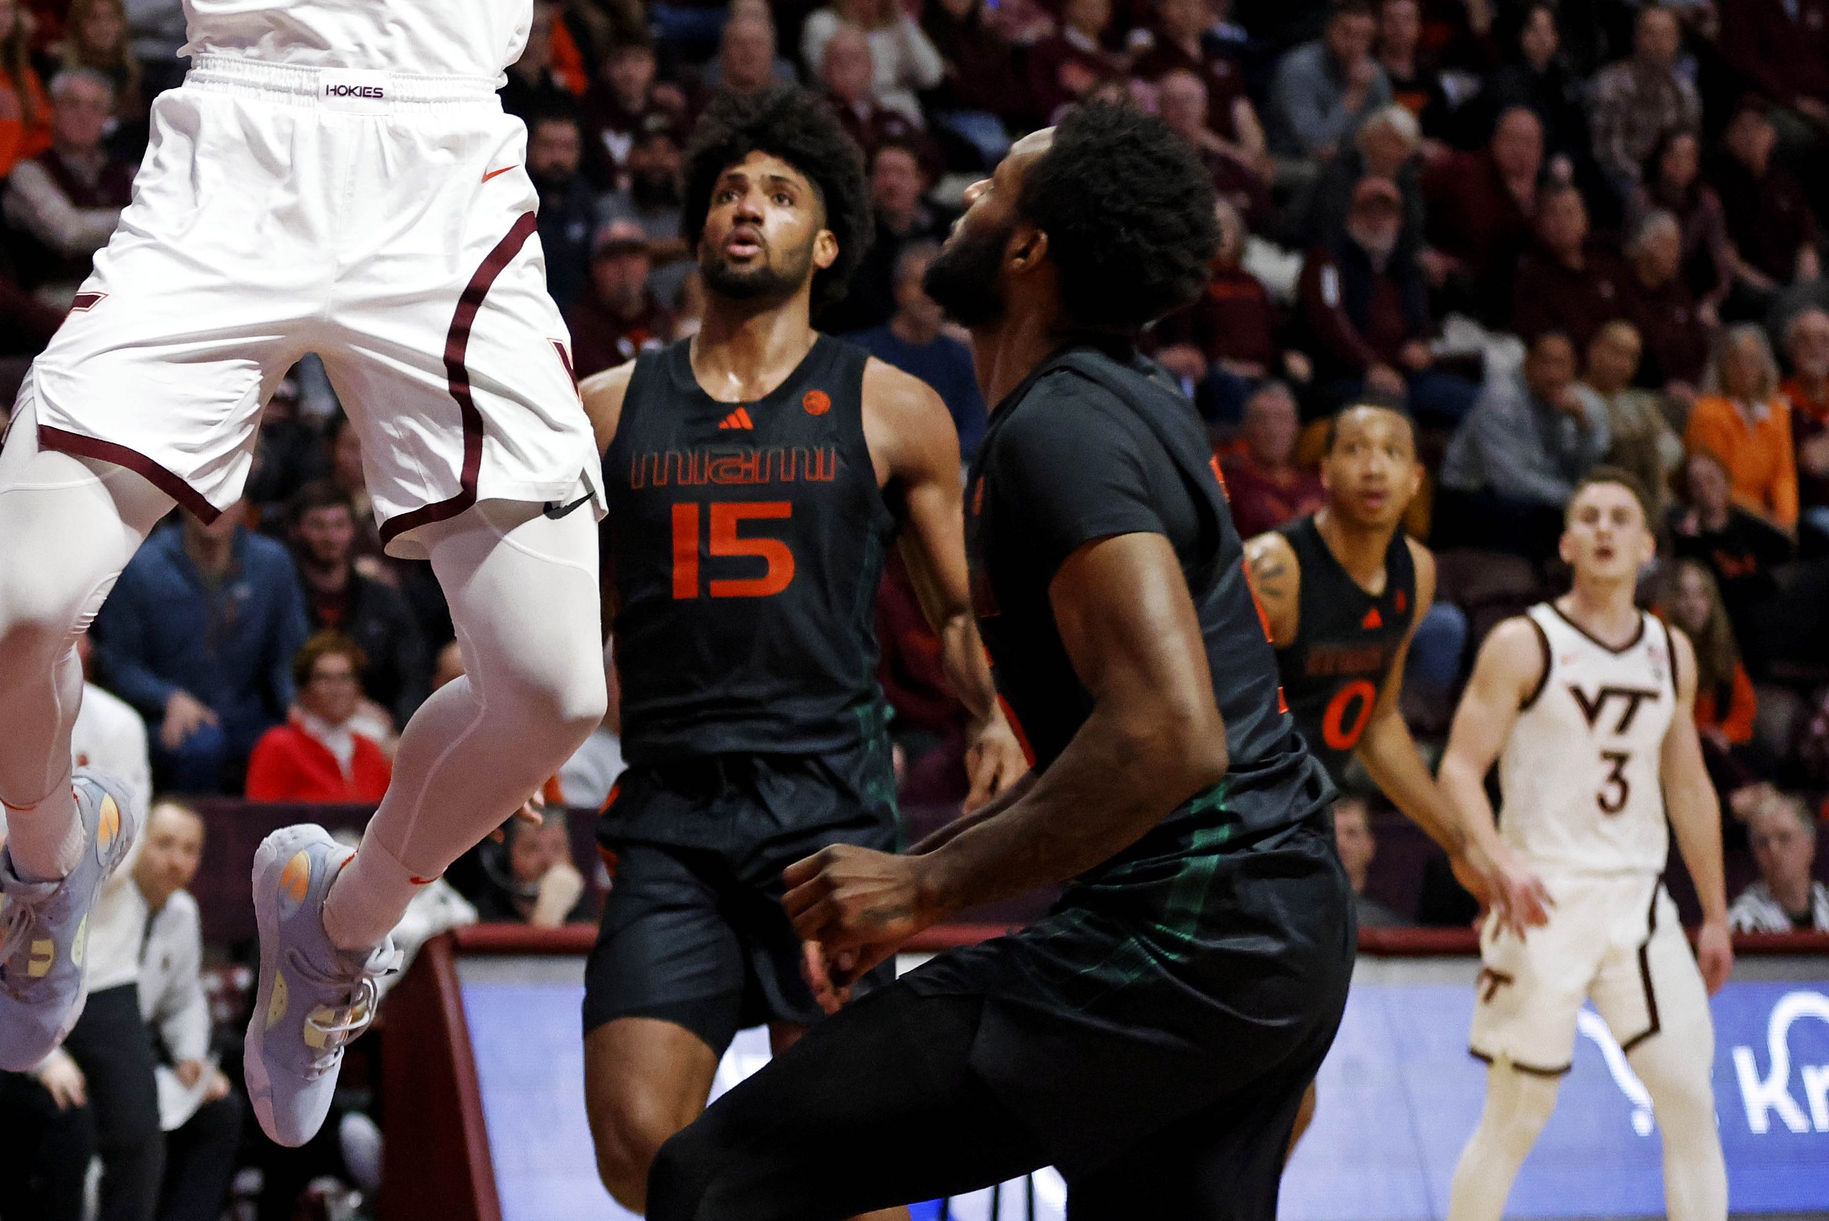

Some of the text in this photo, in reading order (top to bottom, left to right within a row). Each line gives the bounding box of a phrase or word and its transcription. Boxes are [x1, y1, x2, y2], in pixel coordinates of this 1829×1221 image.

[325, 83, 385, 99] HOKIES
[670, 500, 797, 601] 15
[1321, 677, 1377, 752] 0
[1567, 684, 1660, 737] VT
[1594, 749, 1630, 816] 3
